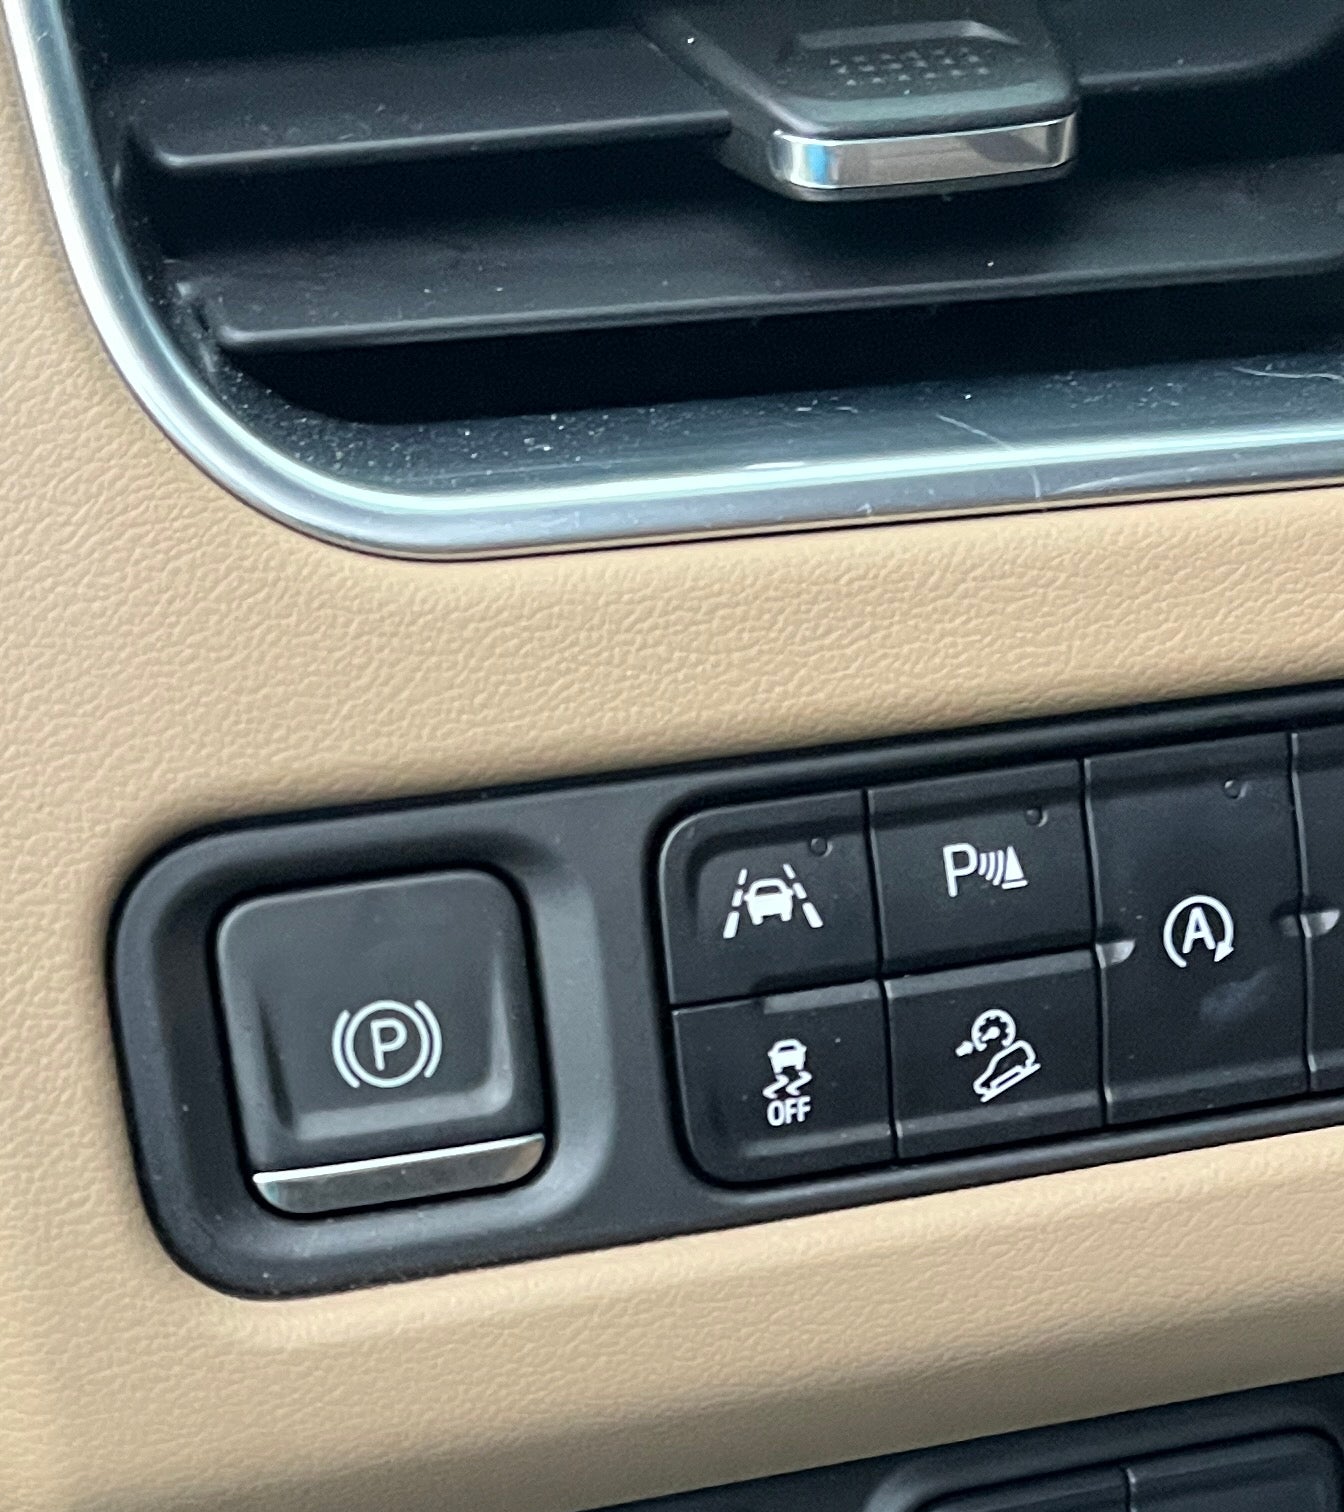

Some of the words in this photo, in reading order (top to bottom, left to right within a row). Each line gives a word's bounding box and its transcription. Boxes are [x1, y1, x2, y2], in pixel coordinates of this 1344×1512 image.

[942, 842, 978, 898] P
[1181, 905, 1217, 955] A
[370, 1018, 408, 1072] P
[765, 1094, 812, 1128] OFF
